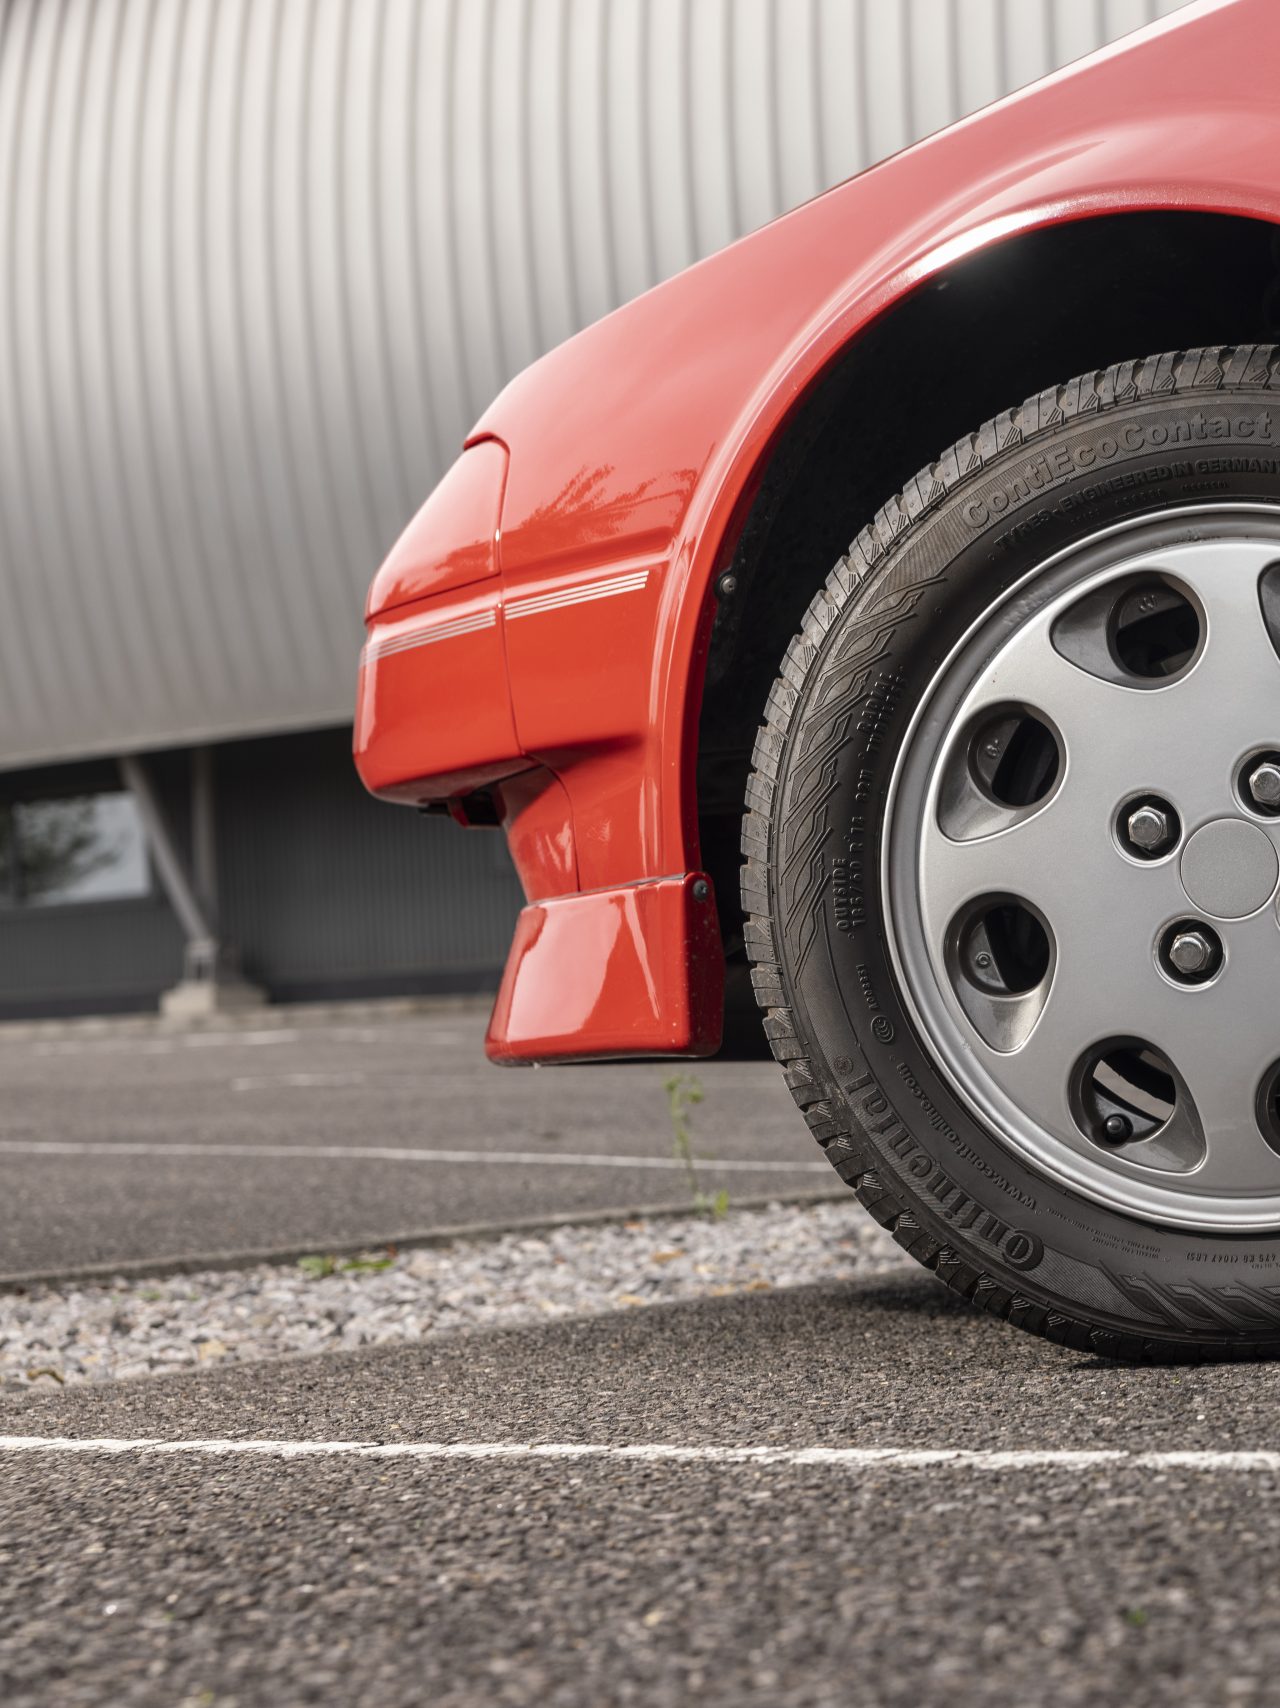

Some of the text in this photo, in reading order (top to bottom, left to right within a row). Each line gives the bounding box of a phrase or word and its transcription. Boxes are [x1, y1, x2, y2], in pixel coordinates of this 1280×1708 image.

[960, 410, 1271, 529] ContiEcoContact
[1058, 462, 1172, 514] ENGINEERED
[1170, 458, 1194, 478] IN
[831, 856, 851, 931] OUTSIDE
[843, 1071, 1046, 1272] Continental
[892, 1060, 1037, 1214] www.conti-online.com
